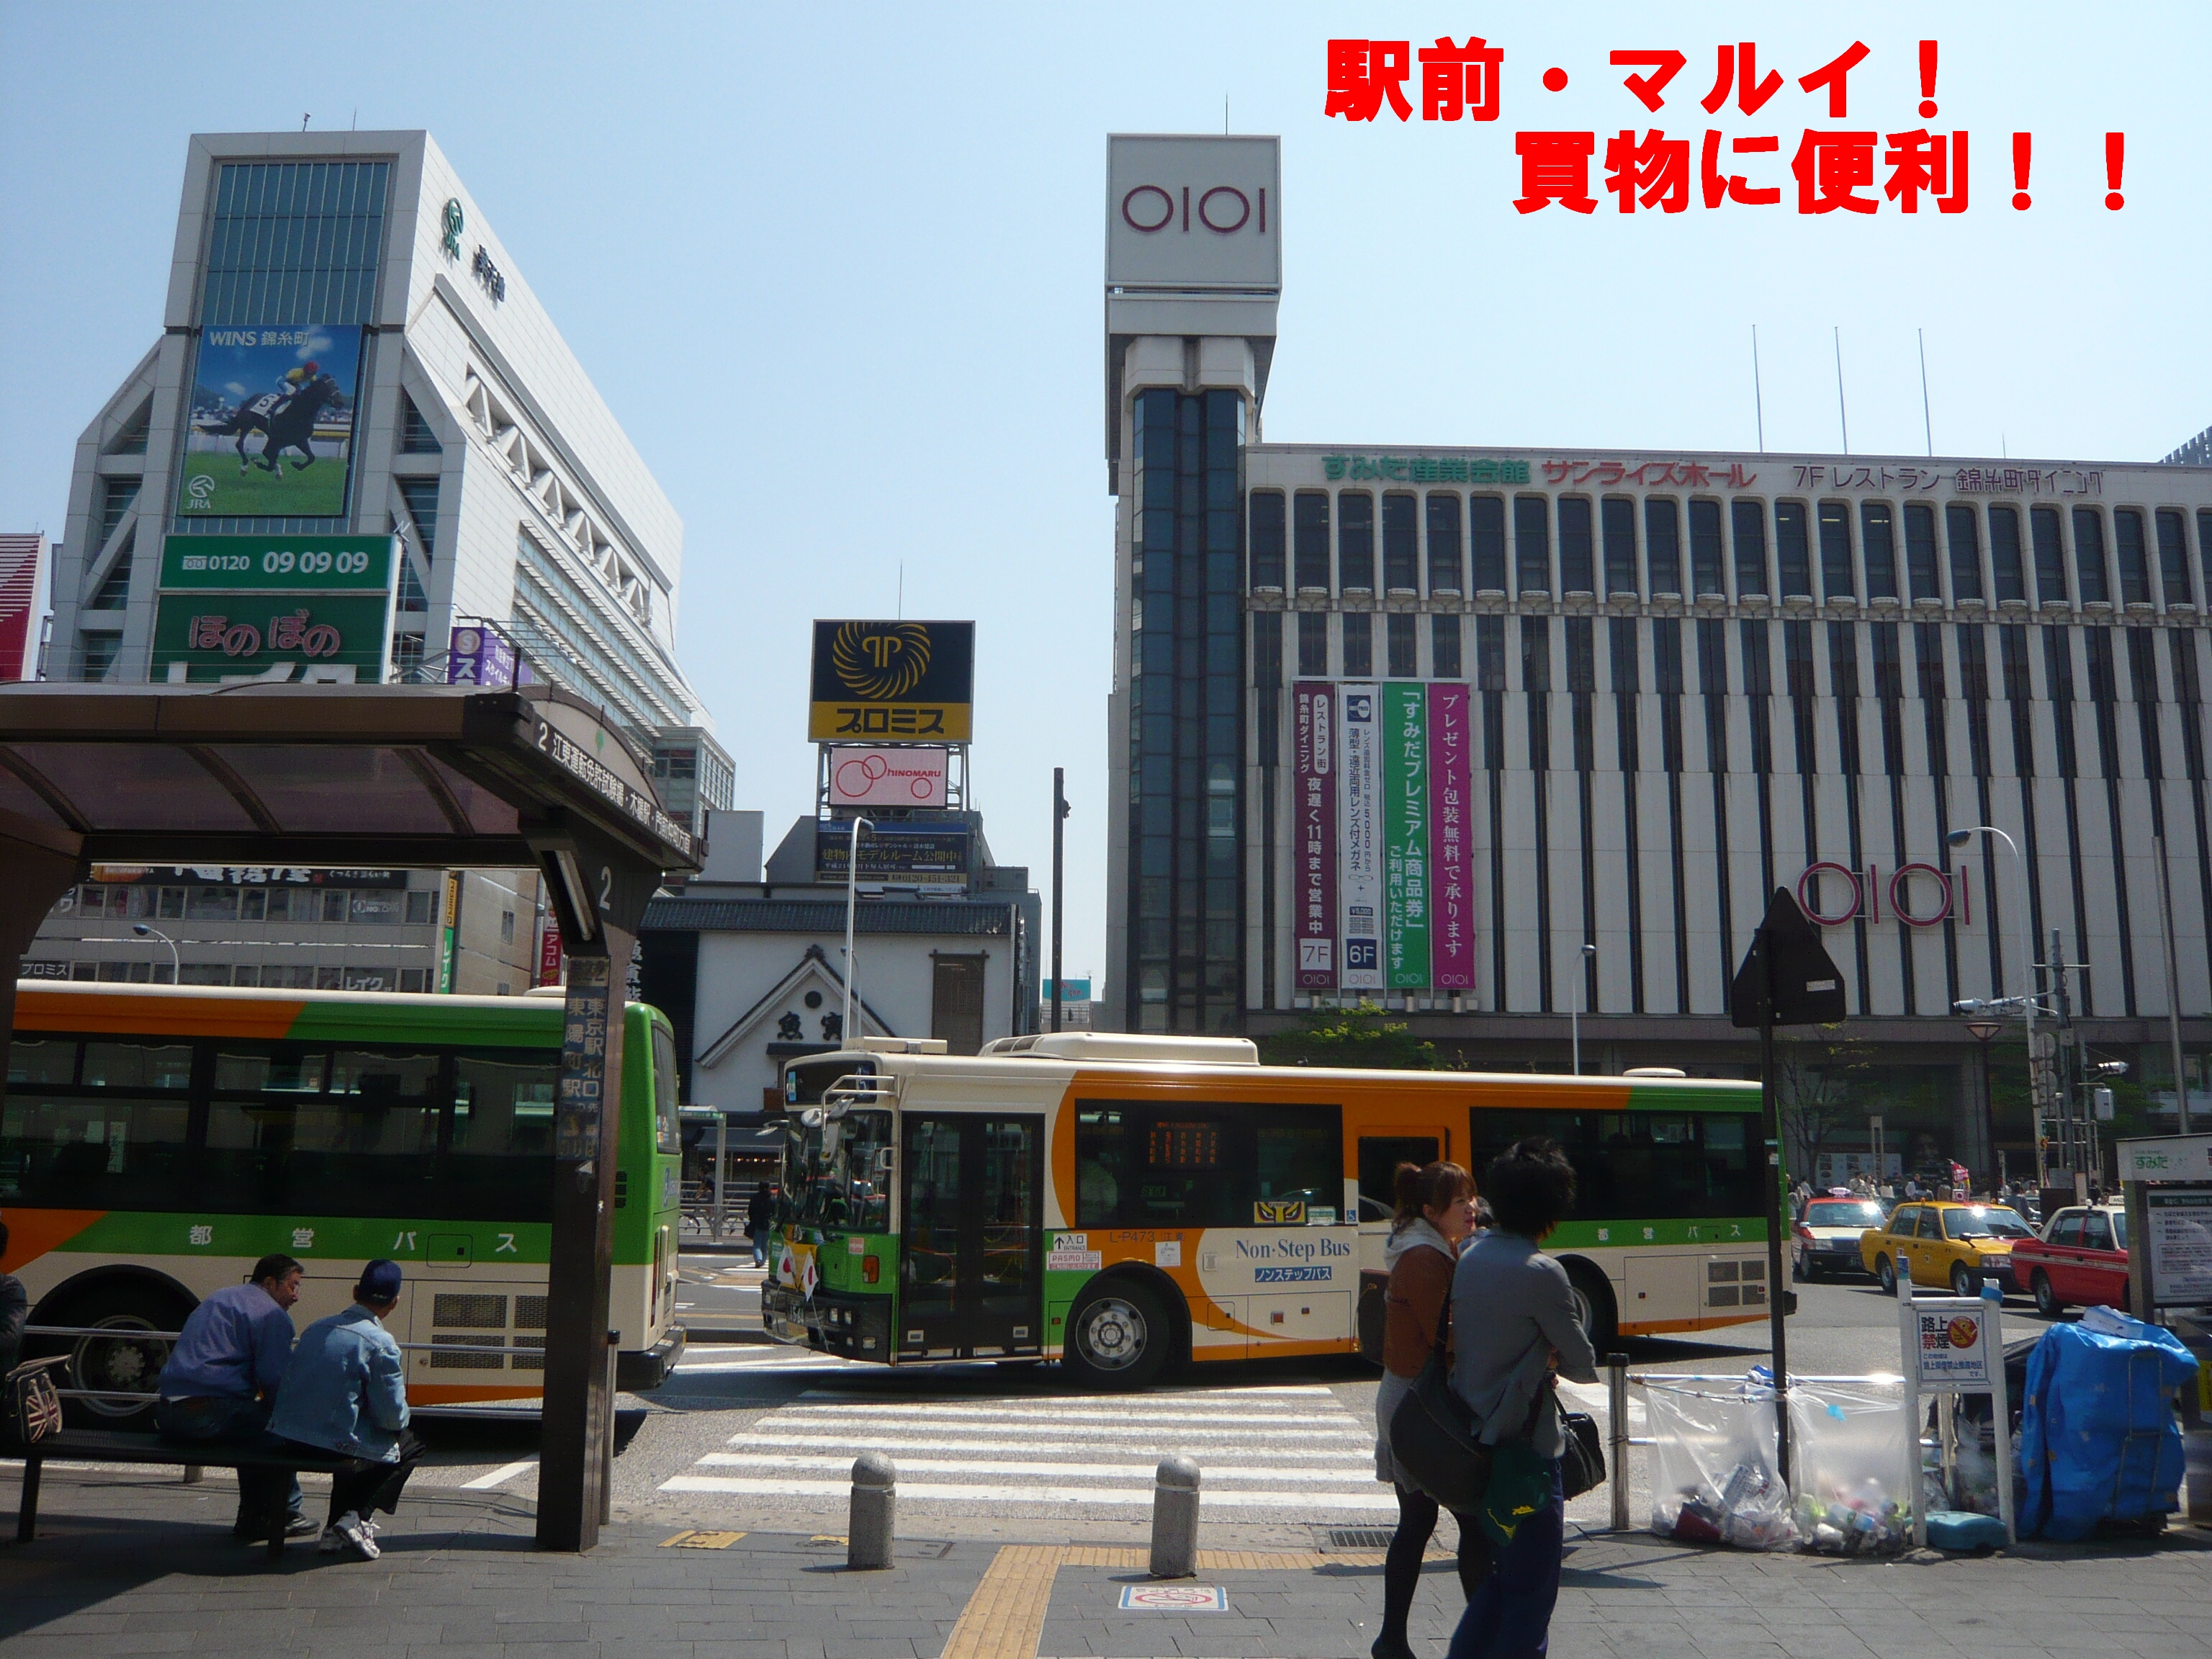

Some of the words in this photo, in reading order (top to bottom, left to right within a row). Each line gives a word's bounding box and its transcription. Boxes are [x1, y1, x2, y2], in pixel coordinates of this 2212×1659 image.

[209, 331, 257, 346] WINS
[261, 331, 310, 347] 錦糸町
[1321, 455, 1532, 485] すみだ産業会館
[1541, 459, 1758, 488] サンライズホール
[186, 498, 212, 510] JRA
[208, 554, 251, 571] 0120
[189, 608, 341, 657] ほのぼの
[835, 707, 945, 734] プロミス
[1299, 693, 1309, 773] 錦糸町ダイニング
[1316, 699, 1326, 768] レストラン街
[539, 721, 549, 752] 2
[1403, 691, 1424, 928] 「すみだプレミアム商品券」
[1442, 694, 1462, 958] プレゼント包装無料で承ります
[1307, 777, 1323, 935] 夜遅く11時まで営業中
[598, 866, 613, 911] 2
[1388, 845, 1404, 969] ご利用いただけます
[546, 934, 558, 967] アコム
[1303, 945, 1328, 963] 7F
[1349, 945, 1375, 963] 6F
[21, 963, 68, 976] プロミス
[440, 940, 451, 989] レイク
[346, 976, 384, 992] レイク
[562, 997, 585, 1099] 東陽町駅
[582, 997, 605, 1098] 東京駅北口
[2134, 1155, 2169, 1169] すみだ
[1066, 1235, 1084, 1245] 入口
[1109, 1231, 1155, 1244] L-P473
[1319, 1237, 1351, 1257] Bus
[1052, 1254, 1081, 1263] PASMO
[1255, 1267, 1332, 1282] ノンステップバス
[1920, 1316, 1948, 1333] 路上
[1921, 1333, 1951, 1350] 禁煙
